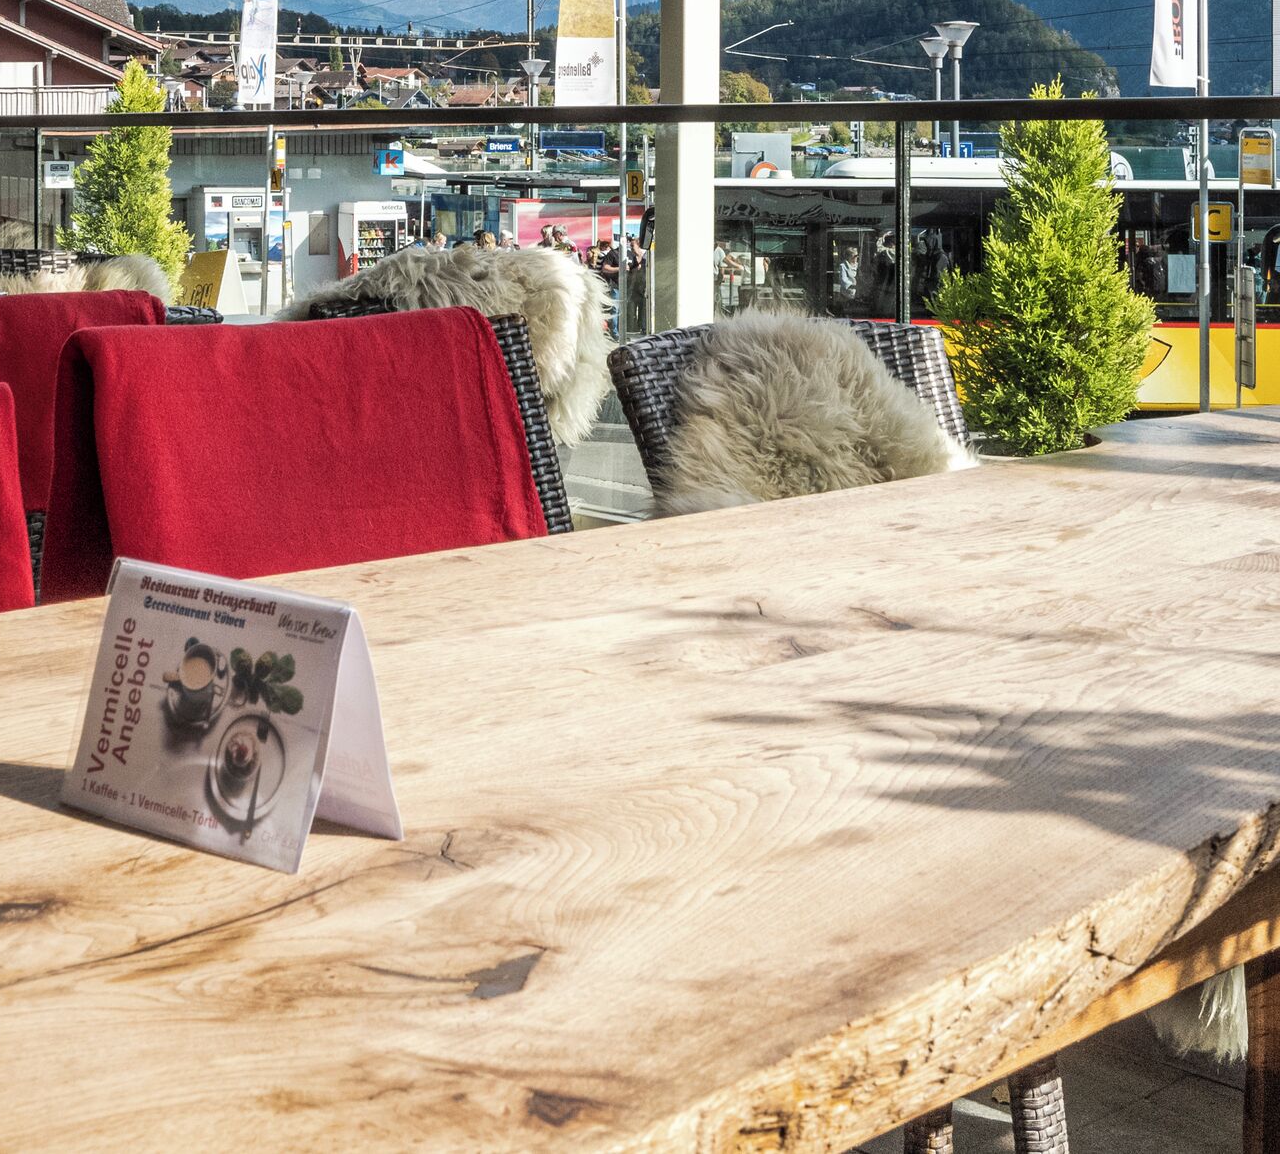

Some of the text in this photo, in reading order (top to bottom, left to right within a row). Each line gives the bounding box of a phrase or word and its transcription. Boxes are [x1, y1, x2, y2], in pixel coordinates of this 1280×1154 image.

[489, 142, 513, 151] Brienz
[271, 170, 279, 188] A
[632, 176, 638, 195] B
[234, 197, 261, 206] BANCOMAT
[140, 575, 200, 600] Restaurant
[144, 595, 246, 628] Seerestaurant Löwen
[87, 617, 136, 773] Vermicelle
[112, 638, 154, 765] Angebot
[81, 778, 87, 791] 1
[89, 780, 118, 800] Kaffee
[130, 792, 135, 805] 1
